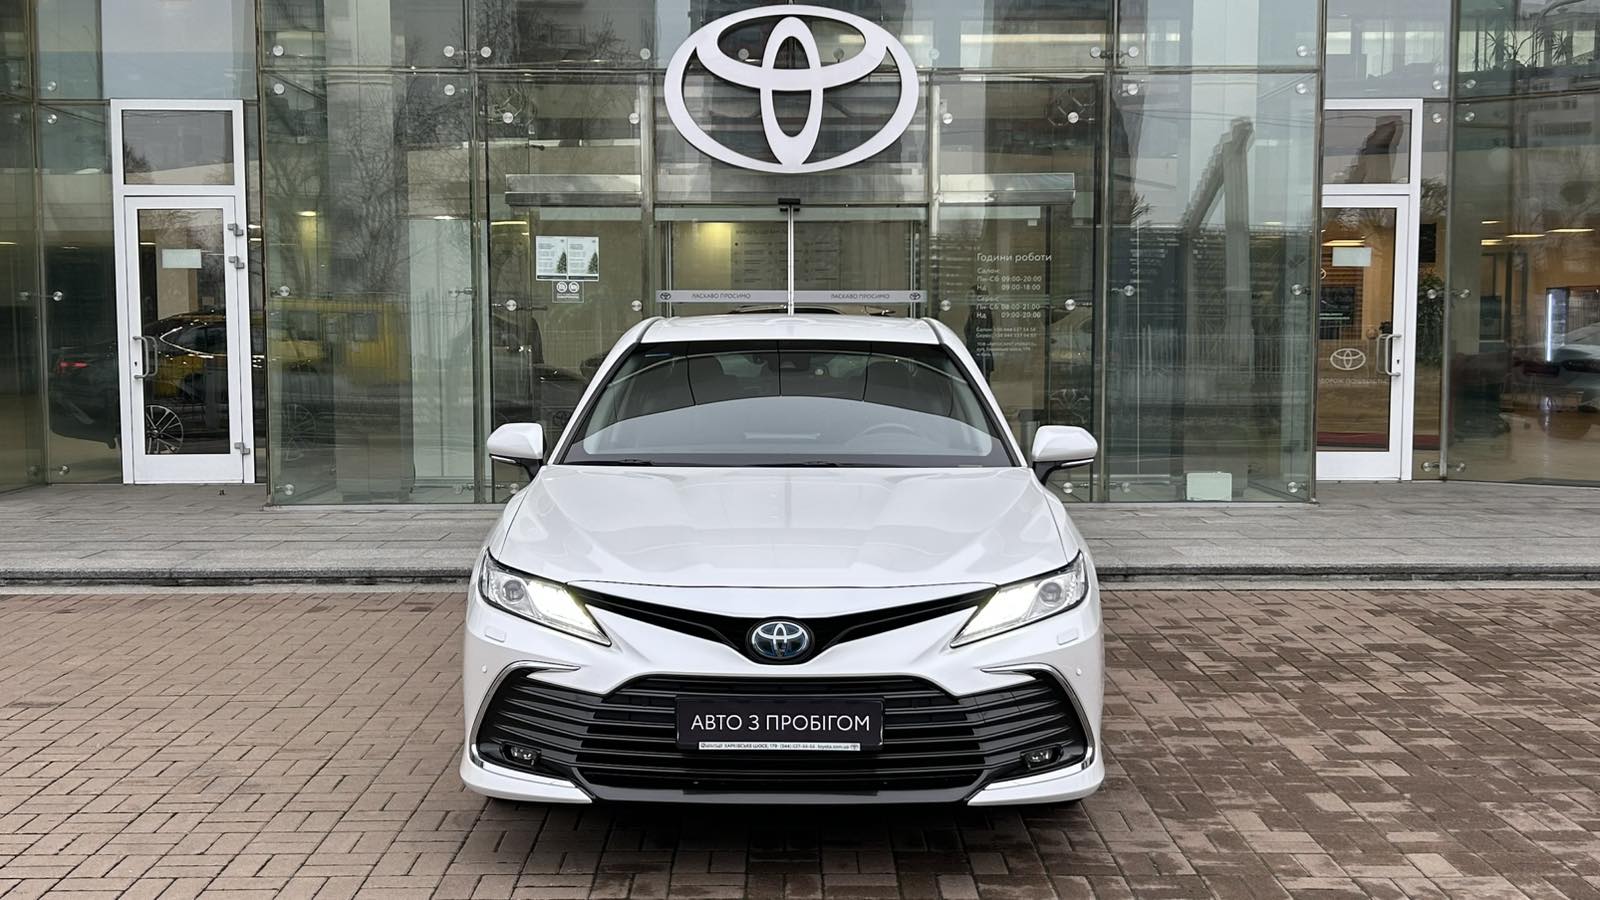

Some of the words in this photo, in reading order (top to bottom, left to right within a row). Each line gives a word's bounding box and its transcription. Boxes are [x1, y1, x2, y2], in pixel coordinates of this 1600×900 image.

[976, 252, 1013, 263] Години
[1014, 251, 1053, 263] роботи
[691, 292, 719, 300] ЛАСКАВО
[720, 292, 751, 300] ПРОСИМО
[976, 311, 987, 319] Нд
[690, 714, 742, 731] АВТО
[748, 714, 760, 731] З
[766, 714, 870, 732] ПРОБІГОМ
